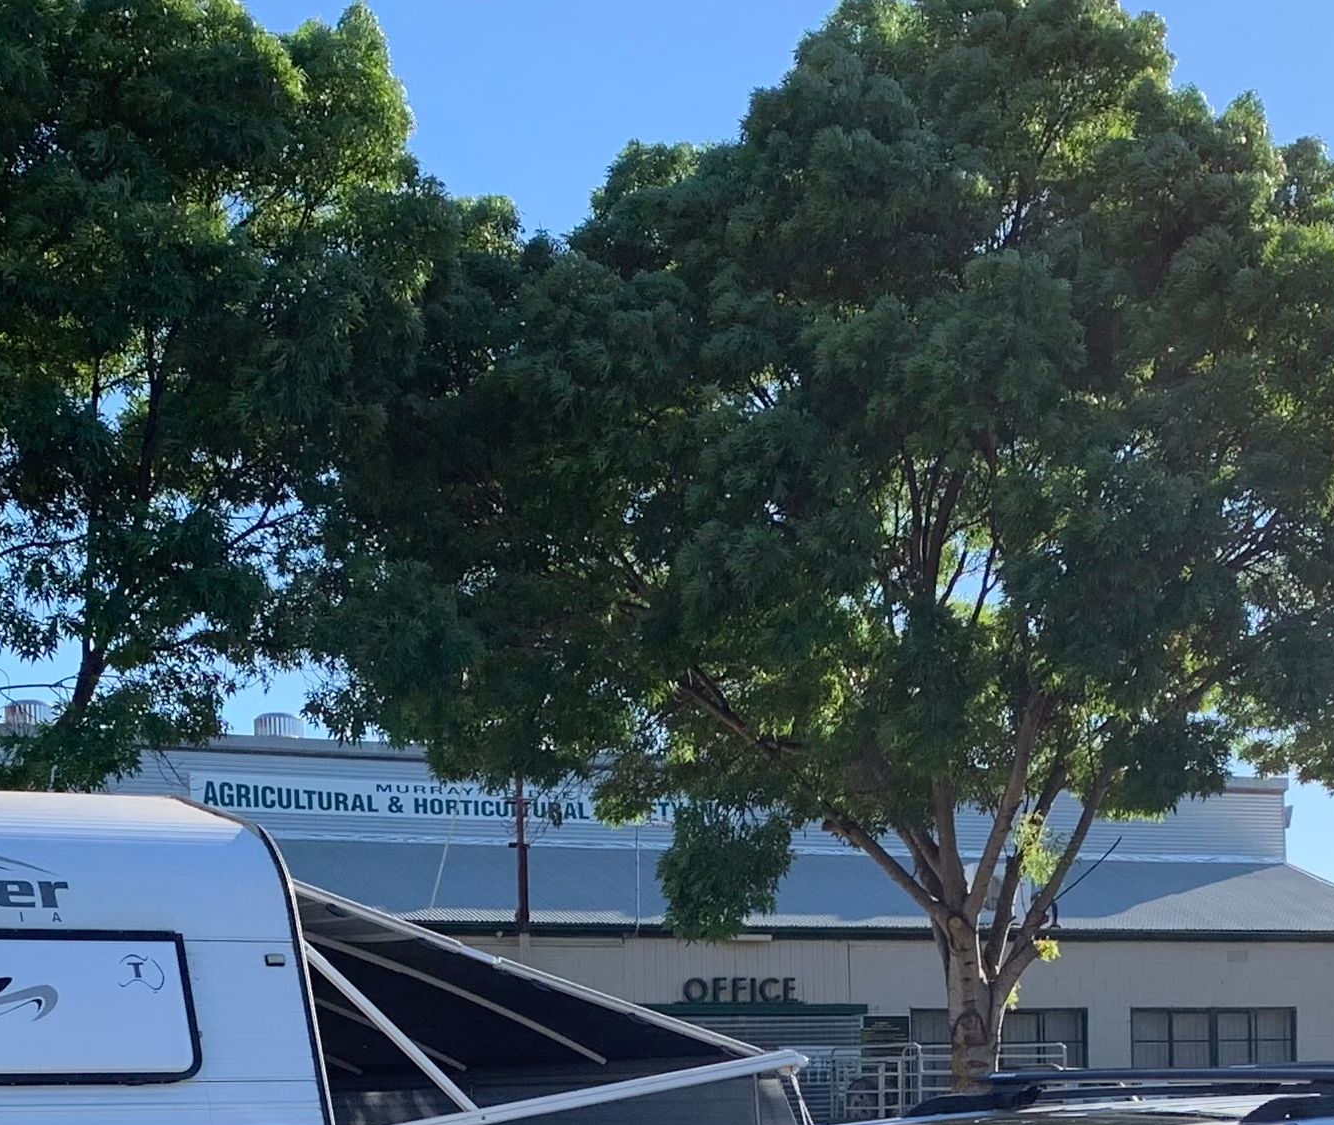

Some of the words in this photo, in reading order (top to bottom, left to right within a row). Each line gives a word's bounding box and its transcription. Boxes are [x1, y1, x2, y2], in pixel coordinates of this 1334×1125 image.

[203, 780, 380, 813] AGRICULTURAL
[387, 795, 404, 814] &
[414, 797, 590, 820] HORTICULUAL
[375, 783, 474, 796] MURRAY
[683, 977, 799, 1002] OFFICE
